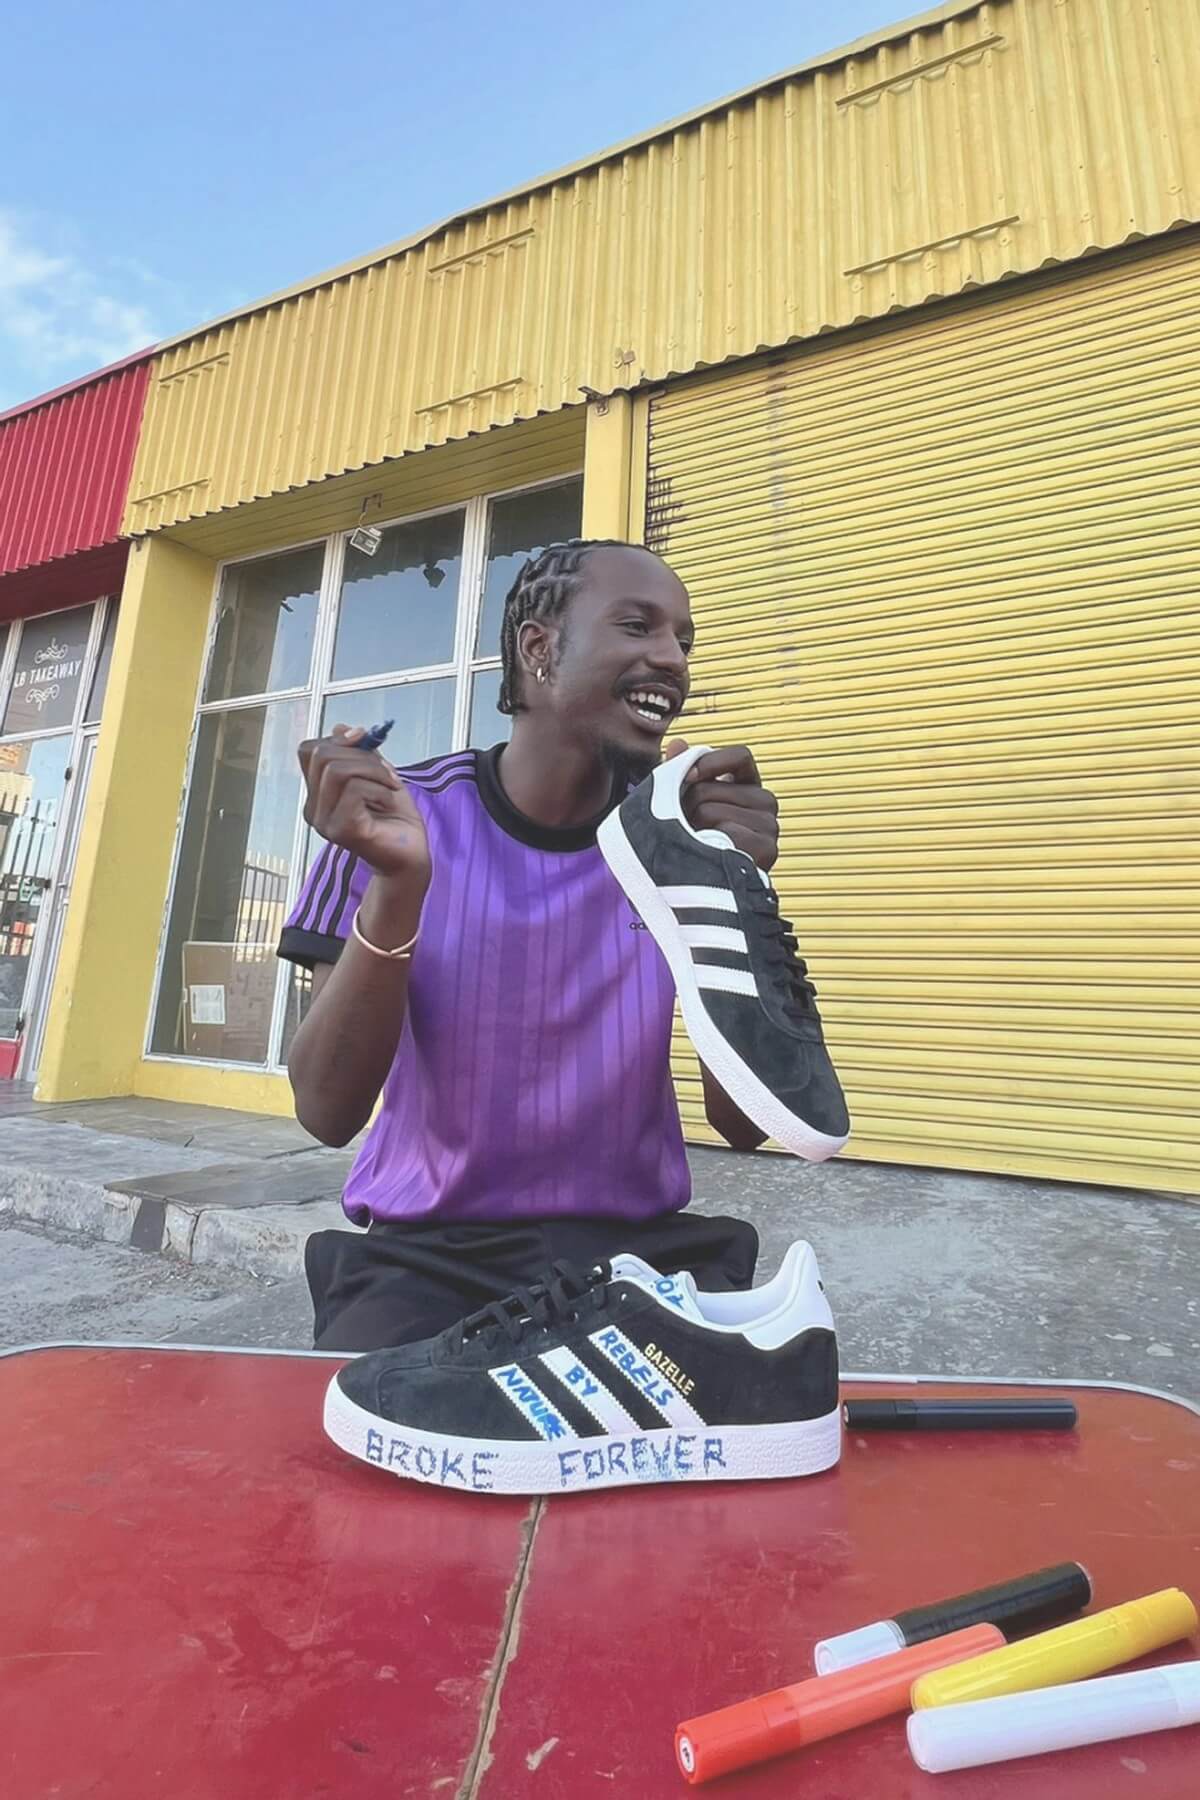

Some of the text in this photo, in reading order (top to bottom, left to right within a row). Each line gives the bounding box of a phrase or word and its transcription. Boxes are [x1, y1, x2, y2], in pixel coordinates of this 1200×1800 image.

[29, 659, 82, 684] TAKEAWAY
[564, 1364, 600, 1397] BY
[598, 1330, 675, 1407] REBELS
[644, 1342, 696, 1396] GAZELLE
[366, 1428, 727, 1489] BROKE FOREVER
